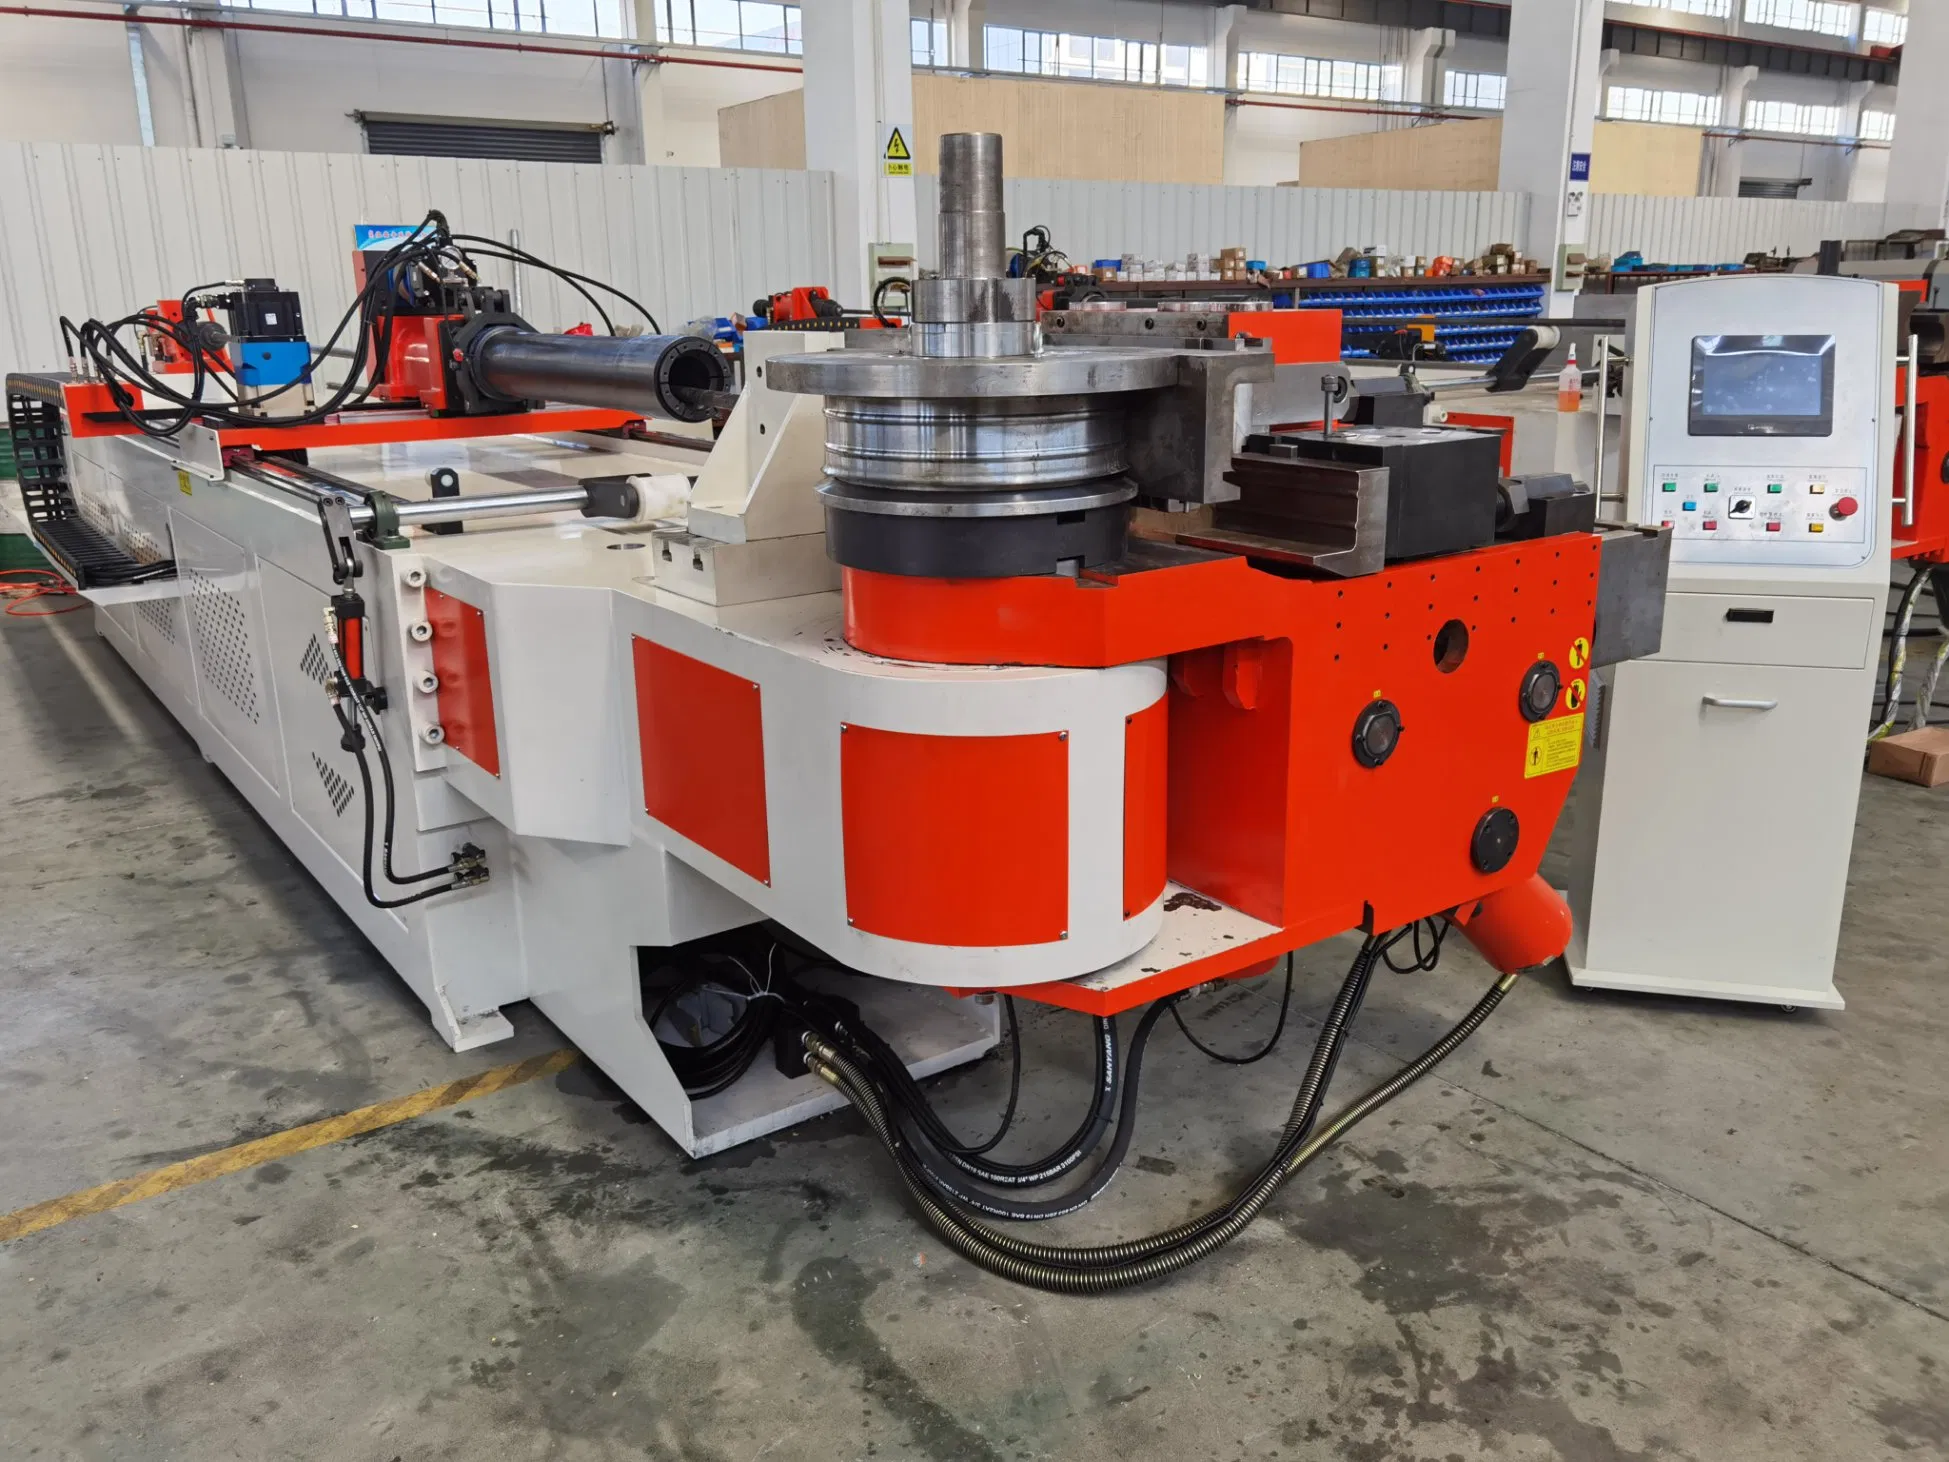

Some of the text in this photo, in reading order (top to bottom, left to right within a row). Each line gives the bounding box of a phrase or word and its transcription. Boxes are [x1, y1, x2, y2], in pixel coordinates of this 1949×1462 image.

[1104, 1034, 1112, 1084] SANYANG
[1028, 1174, 1039, 1182] WP
[1060, 1150, 1082, 1169] 3100PSI
